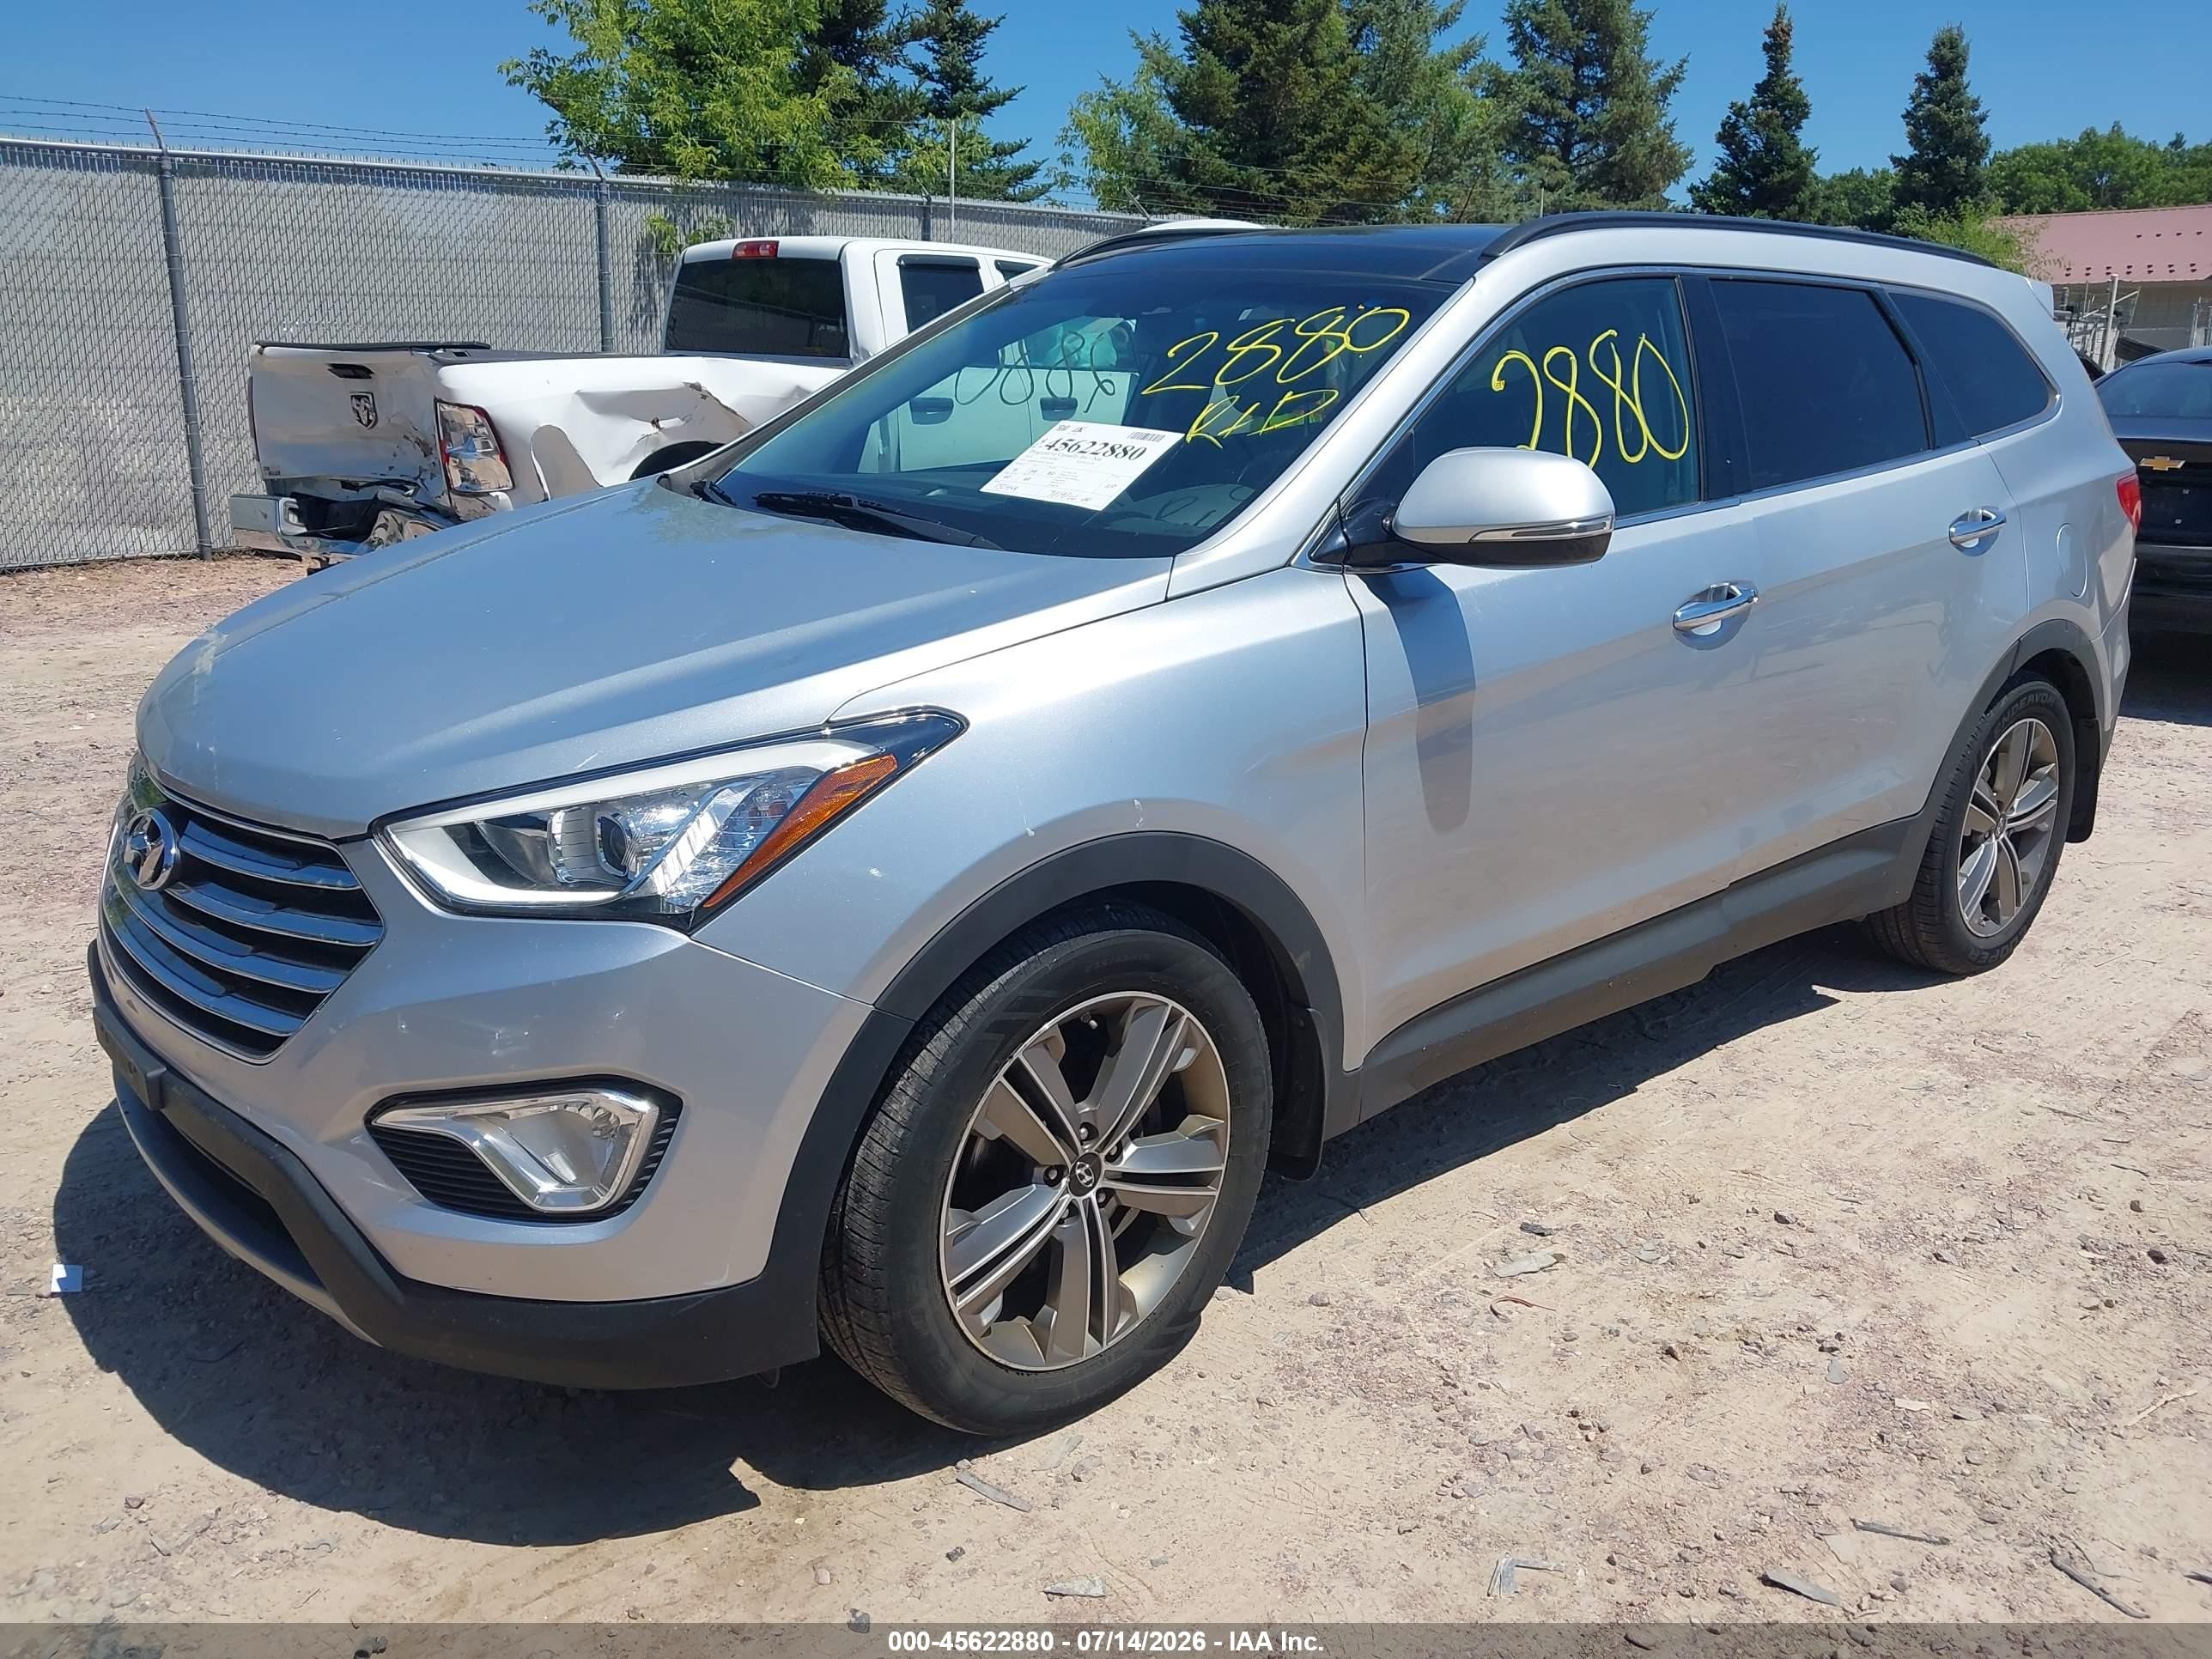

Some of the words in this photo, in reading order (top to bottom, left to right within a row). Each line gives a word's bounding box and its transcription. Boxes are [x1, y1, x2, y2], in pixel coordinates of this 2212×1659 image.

[1141, 306, 1411, 395] 2880
[1491, 328, 1690, 471] 2880
[1044, 437, 1147, 461] 45622880
